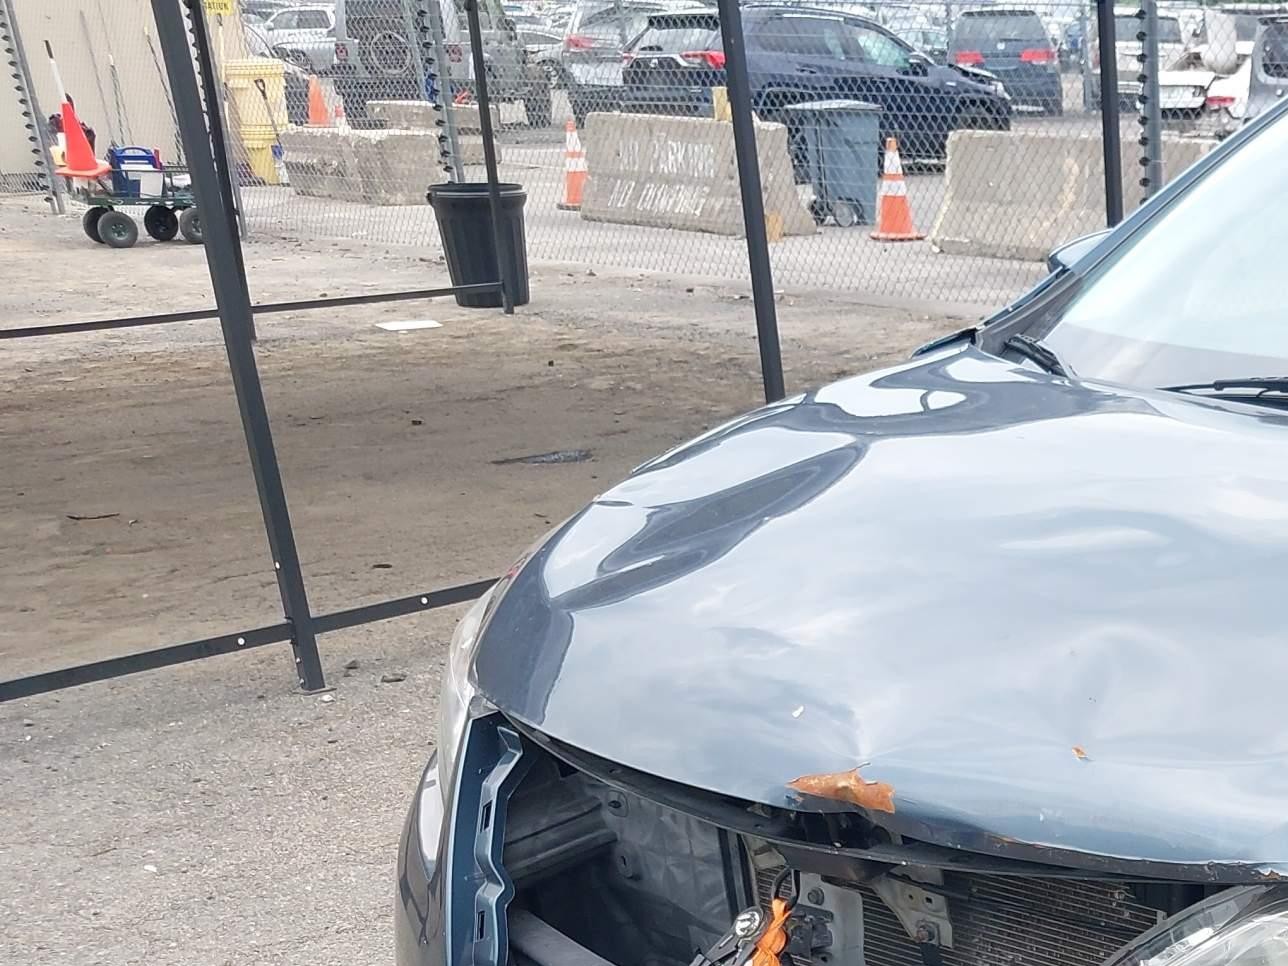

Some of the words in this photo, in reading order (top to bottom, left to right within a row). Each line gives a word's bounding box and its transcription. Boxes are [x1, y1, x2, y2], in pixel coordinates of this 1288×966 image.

[619, 139, 639, 171] NO
[648, 133, 714, 178] PARKING
[607, 179, 636, 208] NO
